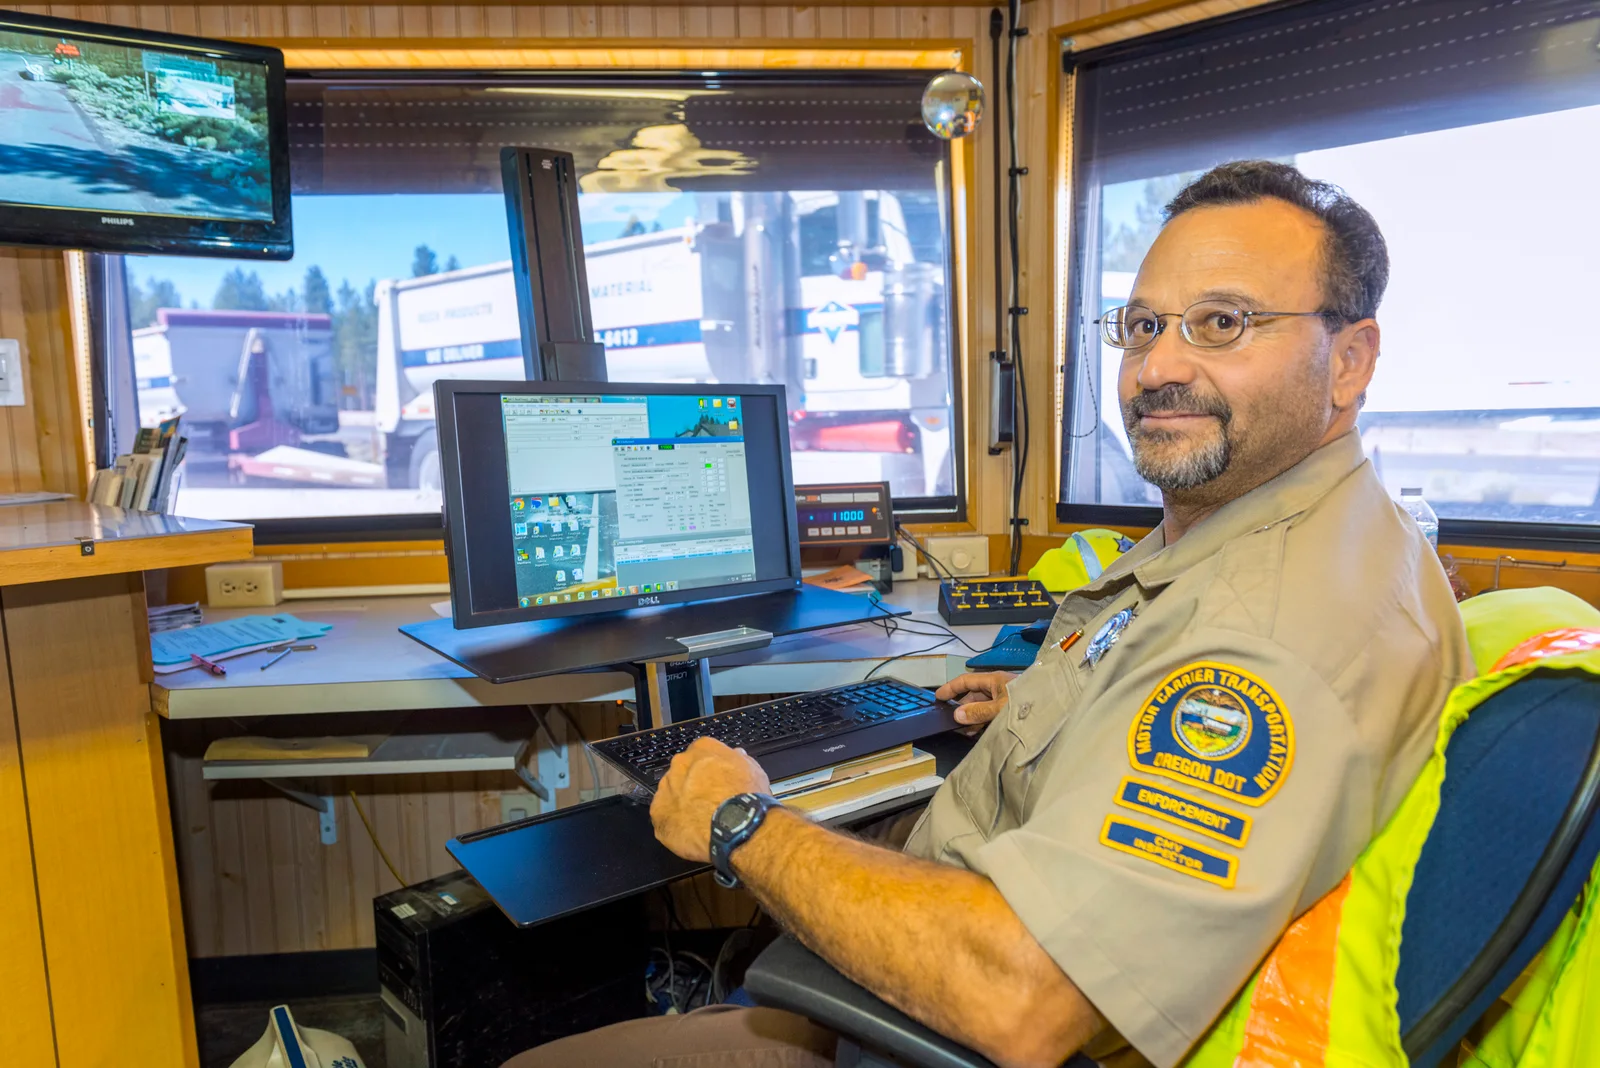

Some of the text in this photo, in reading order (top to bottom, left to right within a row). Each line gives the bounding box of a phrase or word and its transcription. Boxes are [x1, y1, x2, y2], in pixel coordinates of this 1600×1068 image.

[101, 216, 134, 226] PHILIPS
[591, 280, 652, 298] MATERIAL
[833, 510, 864, 522] 11000
[638, 596, 660, 606] DELL
[1136, 668, 1287, 791] MOTOR CARRIER TRANSPORTATION
[823, 744, 846, 753] logitech
[1153, 752, 1247, 793] OREGON DOT
[1137, 788, 1231, 831] ENFORCEMENT
[1154, 836, 1184, 853] CMV
[1134, 837, 1203, 871] INSPECTOR
